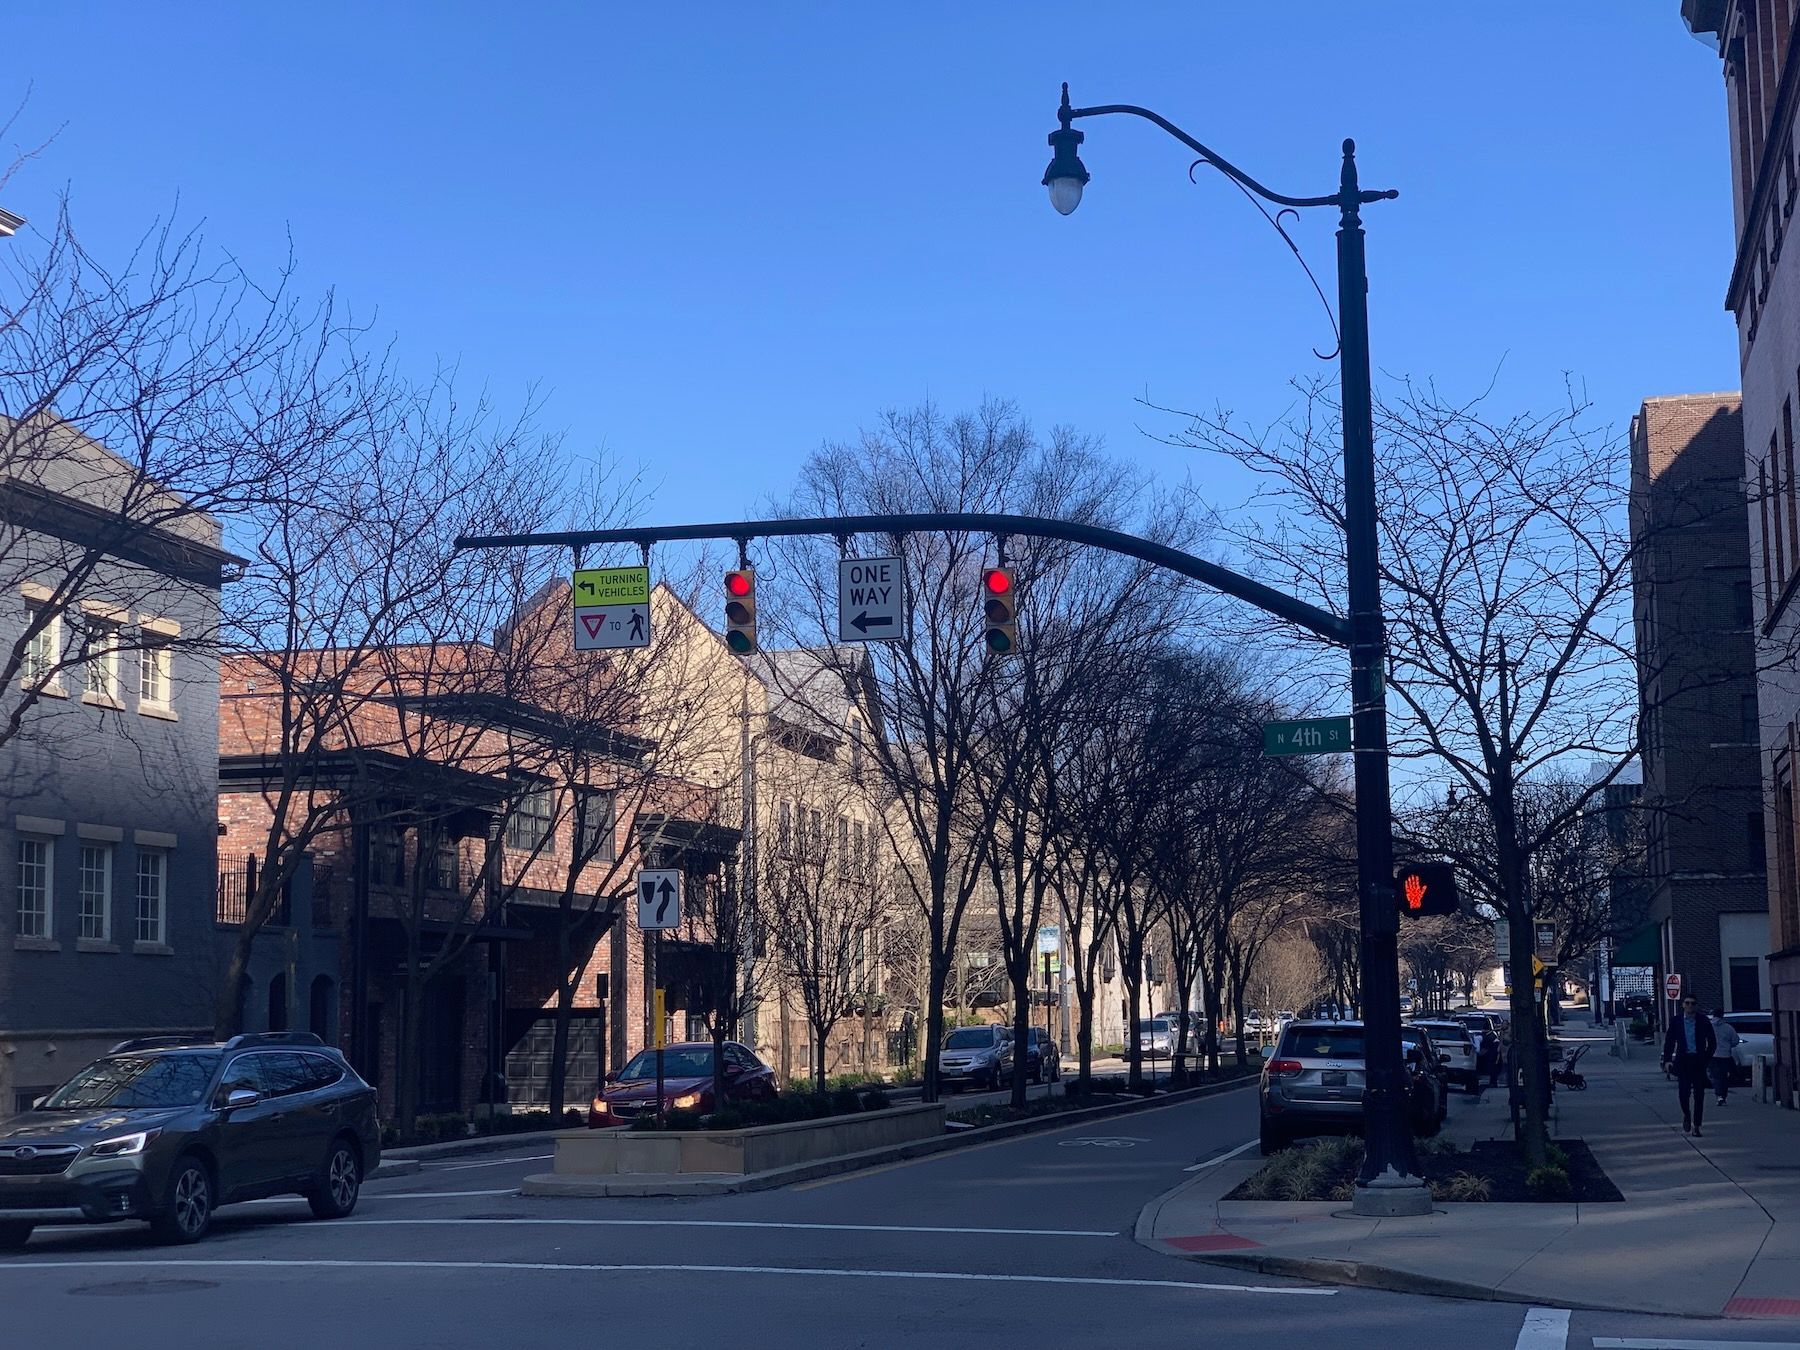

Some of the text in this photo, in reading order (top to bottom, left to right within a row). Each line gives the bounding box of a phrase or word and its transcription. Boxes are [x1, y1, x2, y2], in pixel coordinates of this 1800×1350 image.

[600, 573, 642, 585] TURNING
[851, 565, 891, 584] ONE
[598, 586, 645, 598] VEHICLES
[850, 586, 892, 606] WAY
[609, 621, 621, 631] TO
[1277, 727, 1339, 747] N 4th St
